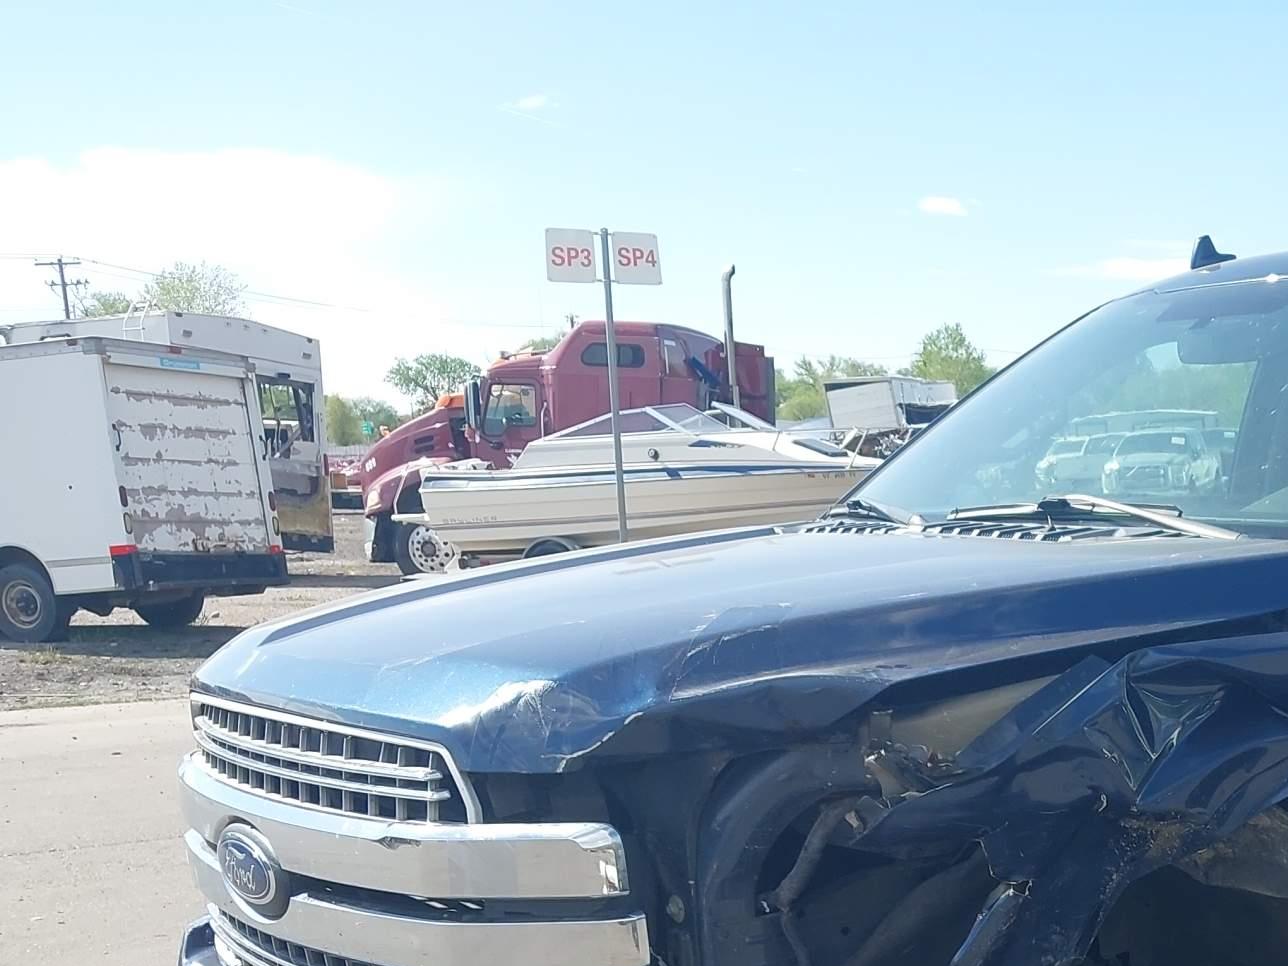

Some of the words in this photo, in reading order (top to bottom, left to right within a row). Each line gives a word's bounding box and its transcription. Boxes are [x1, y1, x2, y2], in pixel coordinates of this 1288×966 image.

[551, 246, 592, 268] SP3
[617, 246, 657, 268] SP4
[224, 845, 256, 892] Ford
